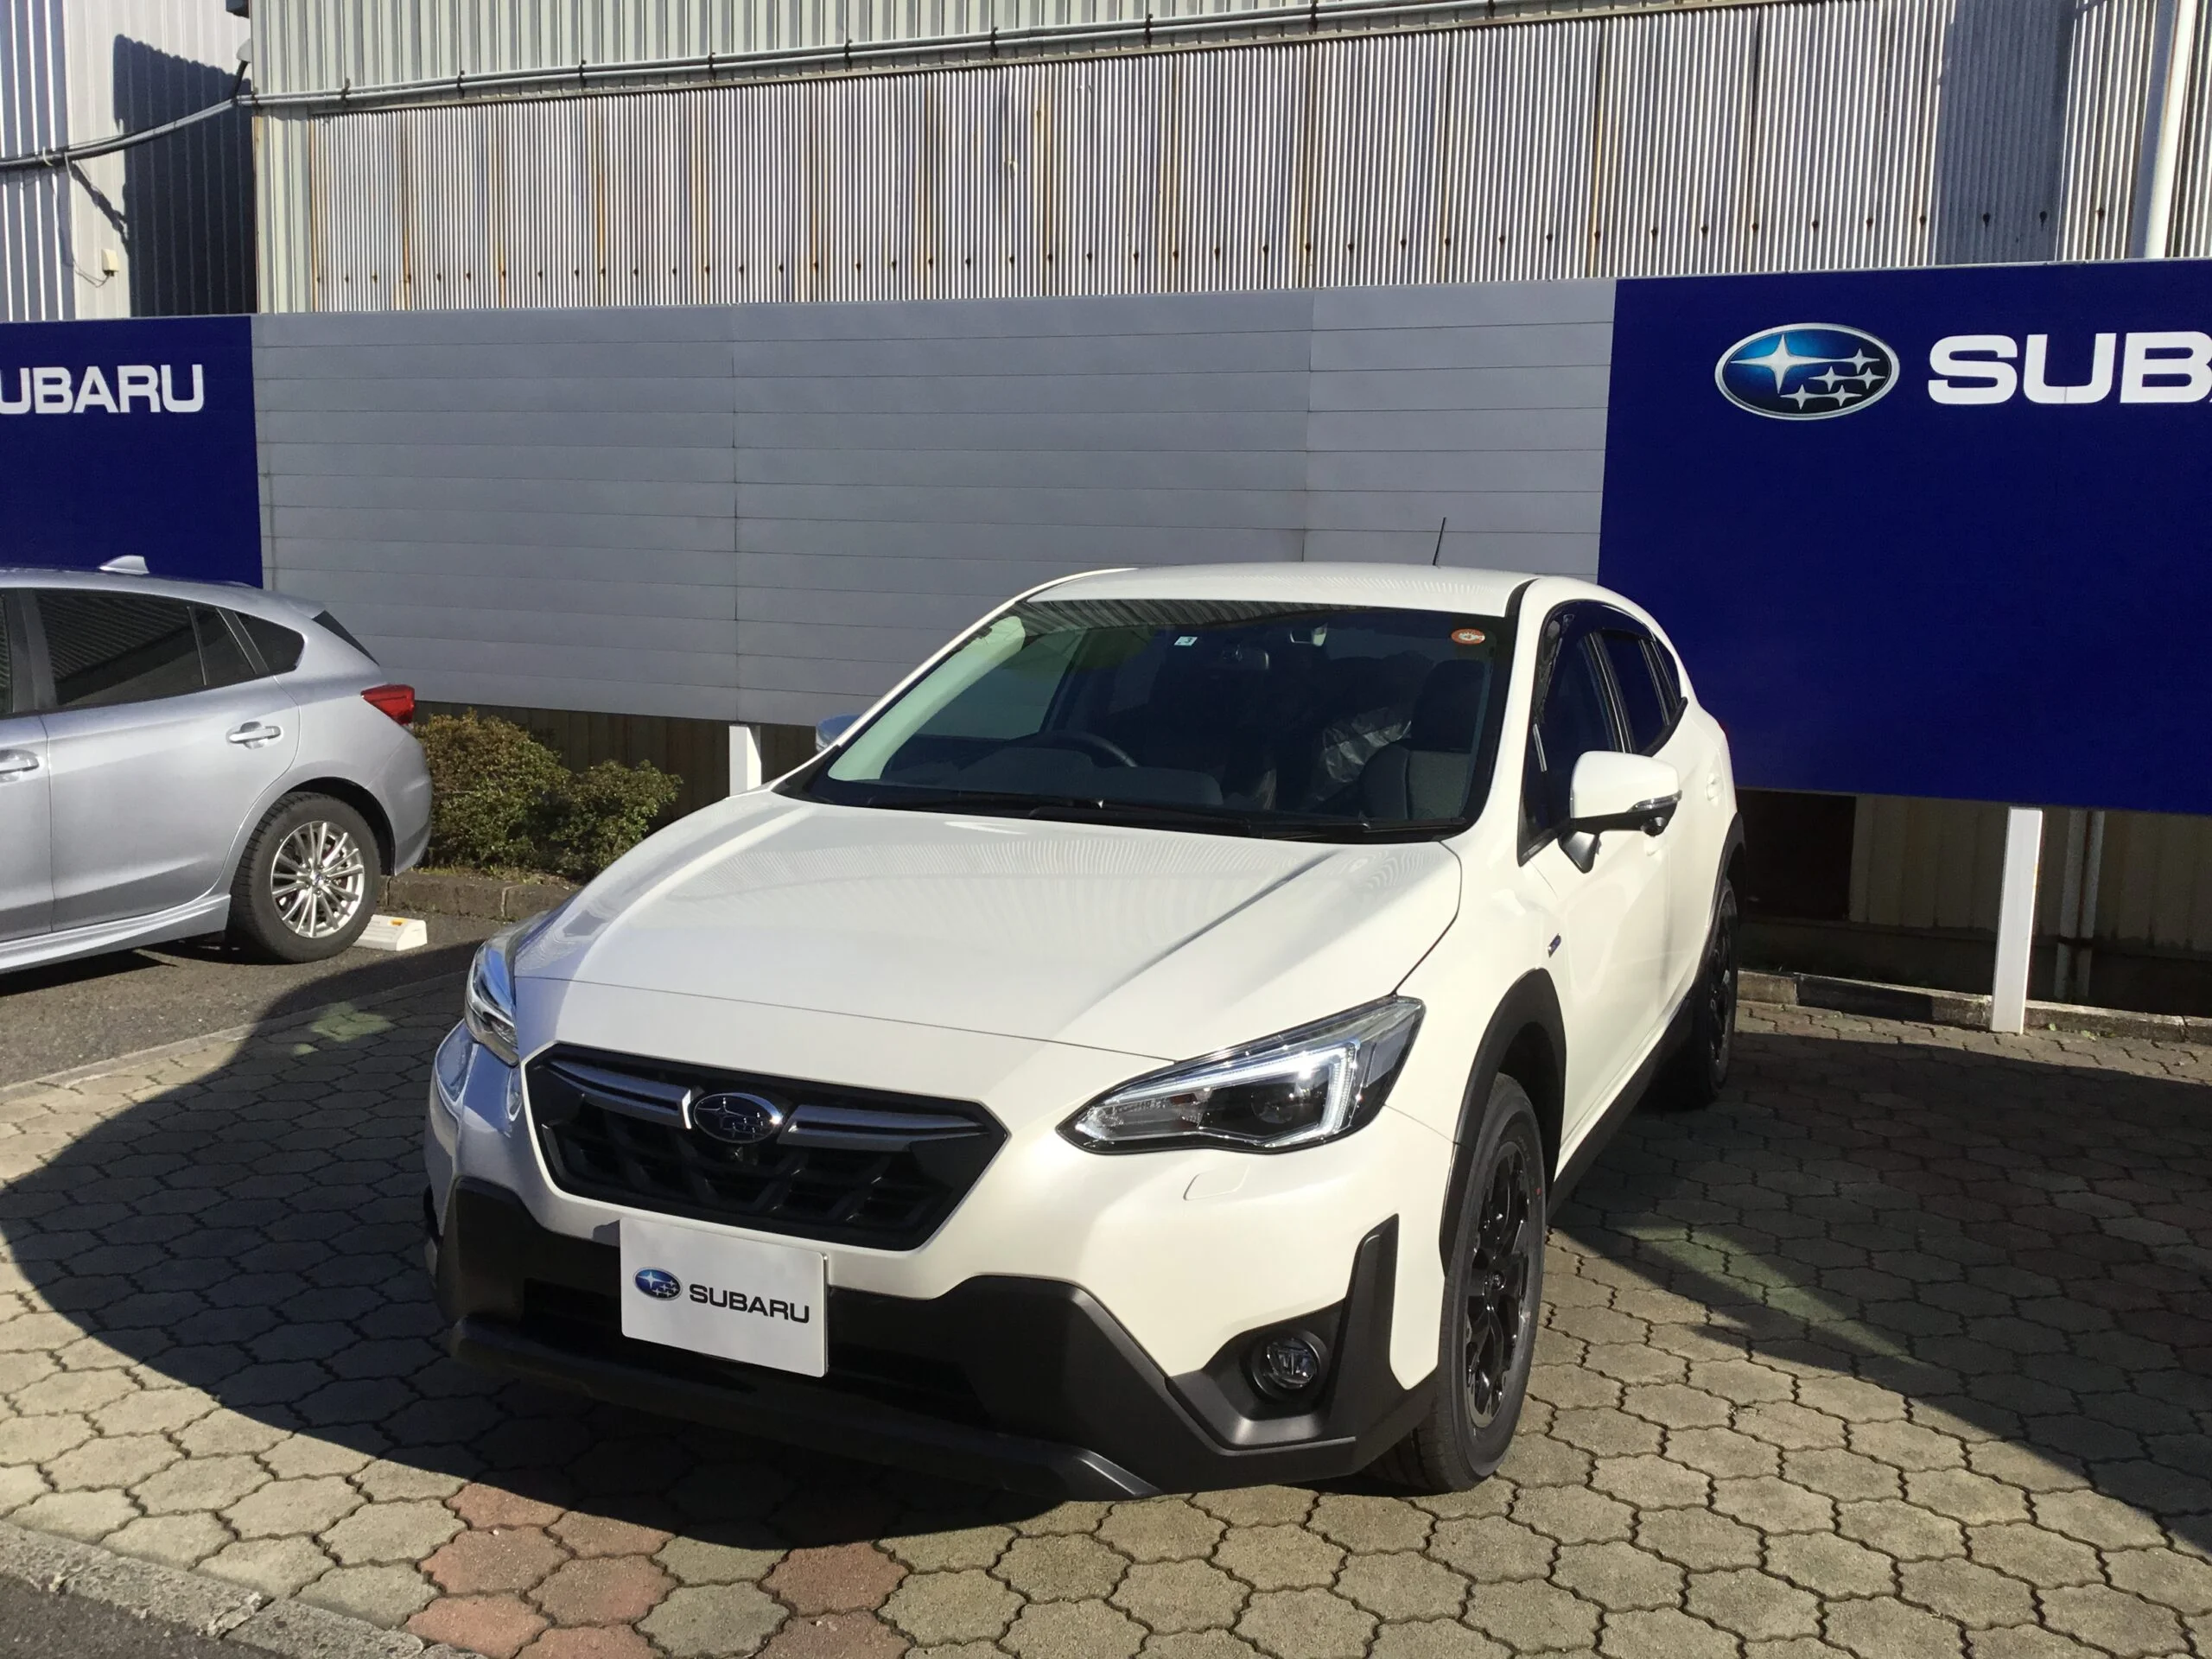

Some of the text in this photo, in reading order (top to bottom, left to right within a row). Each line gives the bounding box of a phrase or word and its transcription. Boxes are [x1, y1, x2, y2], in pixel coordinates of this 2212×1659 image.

[0, 364, 205, 415] UBARU
[1928, 331, 2212, 405] SUB
[689, 1283, 810, 1324] SUBARU
